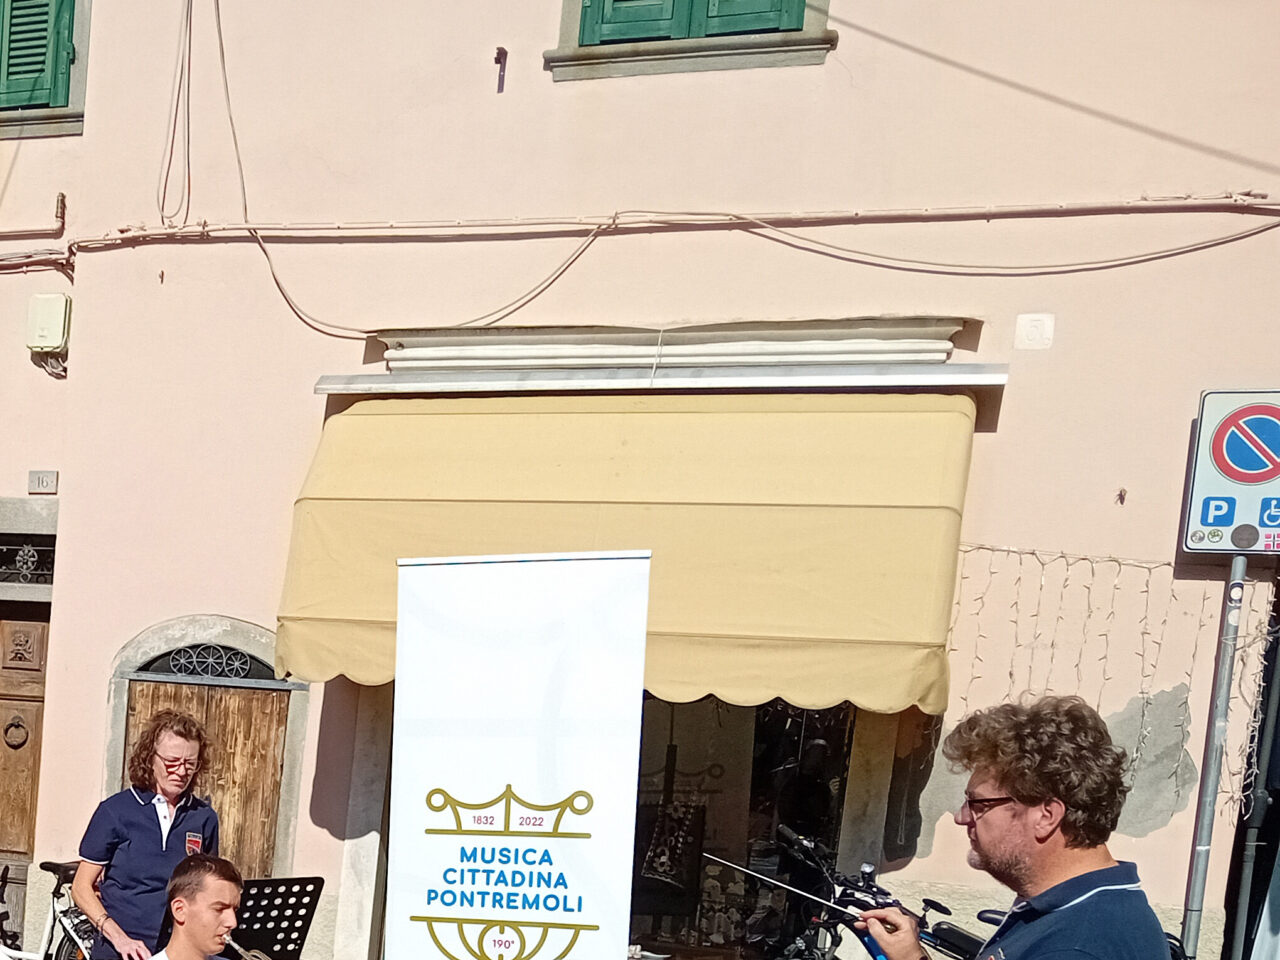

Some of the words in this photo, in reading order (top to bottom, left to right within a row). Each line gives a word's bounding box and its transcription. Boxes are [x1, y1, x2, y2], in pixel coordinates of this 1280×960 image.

[37, 475, 49, 489] 16
[1207, 500, 1229, 524] P
[472, 816, 495, 826] 1832
[519, 816, 544, 827] 2022
[460, 846, 553, 866] MUSICA
[443, 868, 568, 890] CITTADINA
[427, 889, 583, 913] PONTREMOLI
